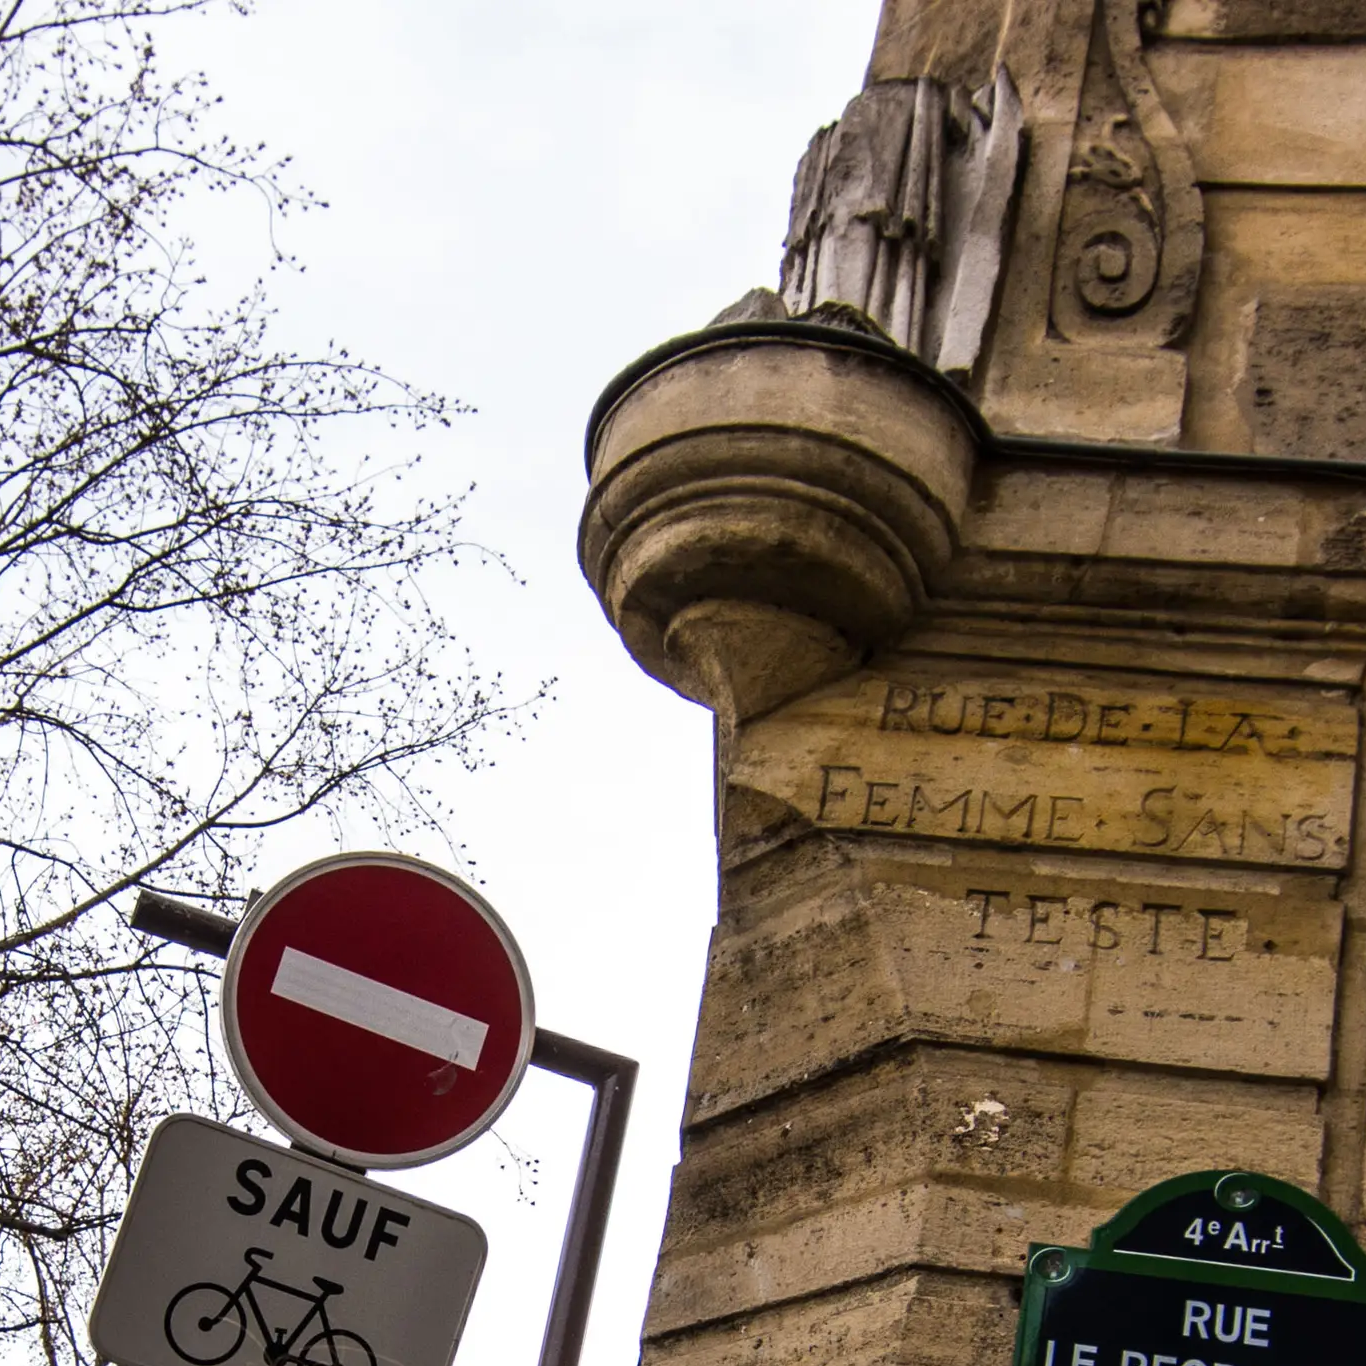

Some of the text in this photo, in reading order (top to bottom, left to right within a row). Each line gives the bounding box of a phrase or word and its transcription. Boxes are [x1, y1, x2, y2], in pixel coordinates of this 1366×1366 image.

[878, 682, 1017, 739] RUE
[1037, 690, 1131, 747] DE
[815, 764, 1085, 844] FEMME
[226, 1158, 410, 1262] SAUF
[1182, 1300, 1272, 1347] RUE
